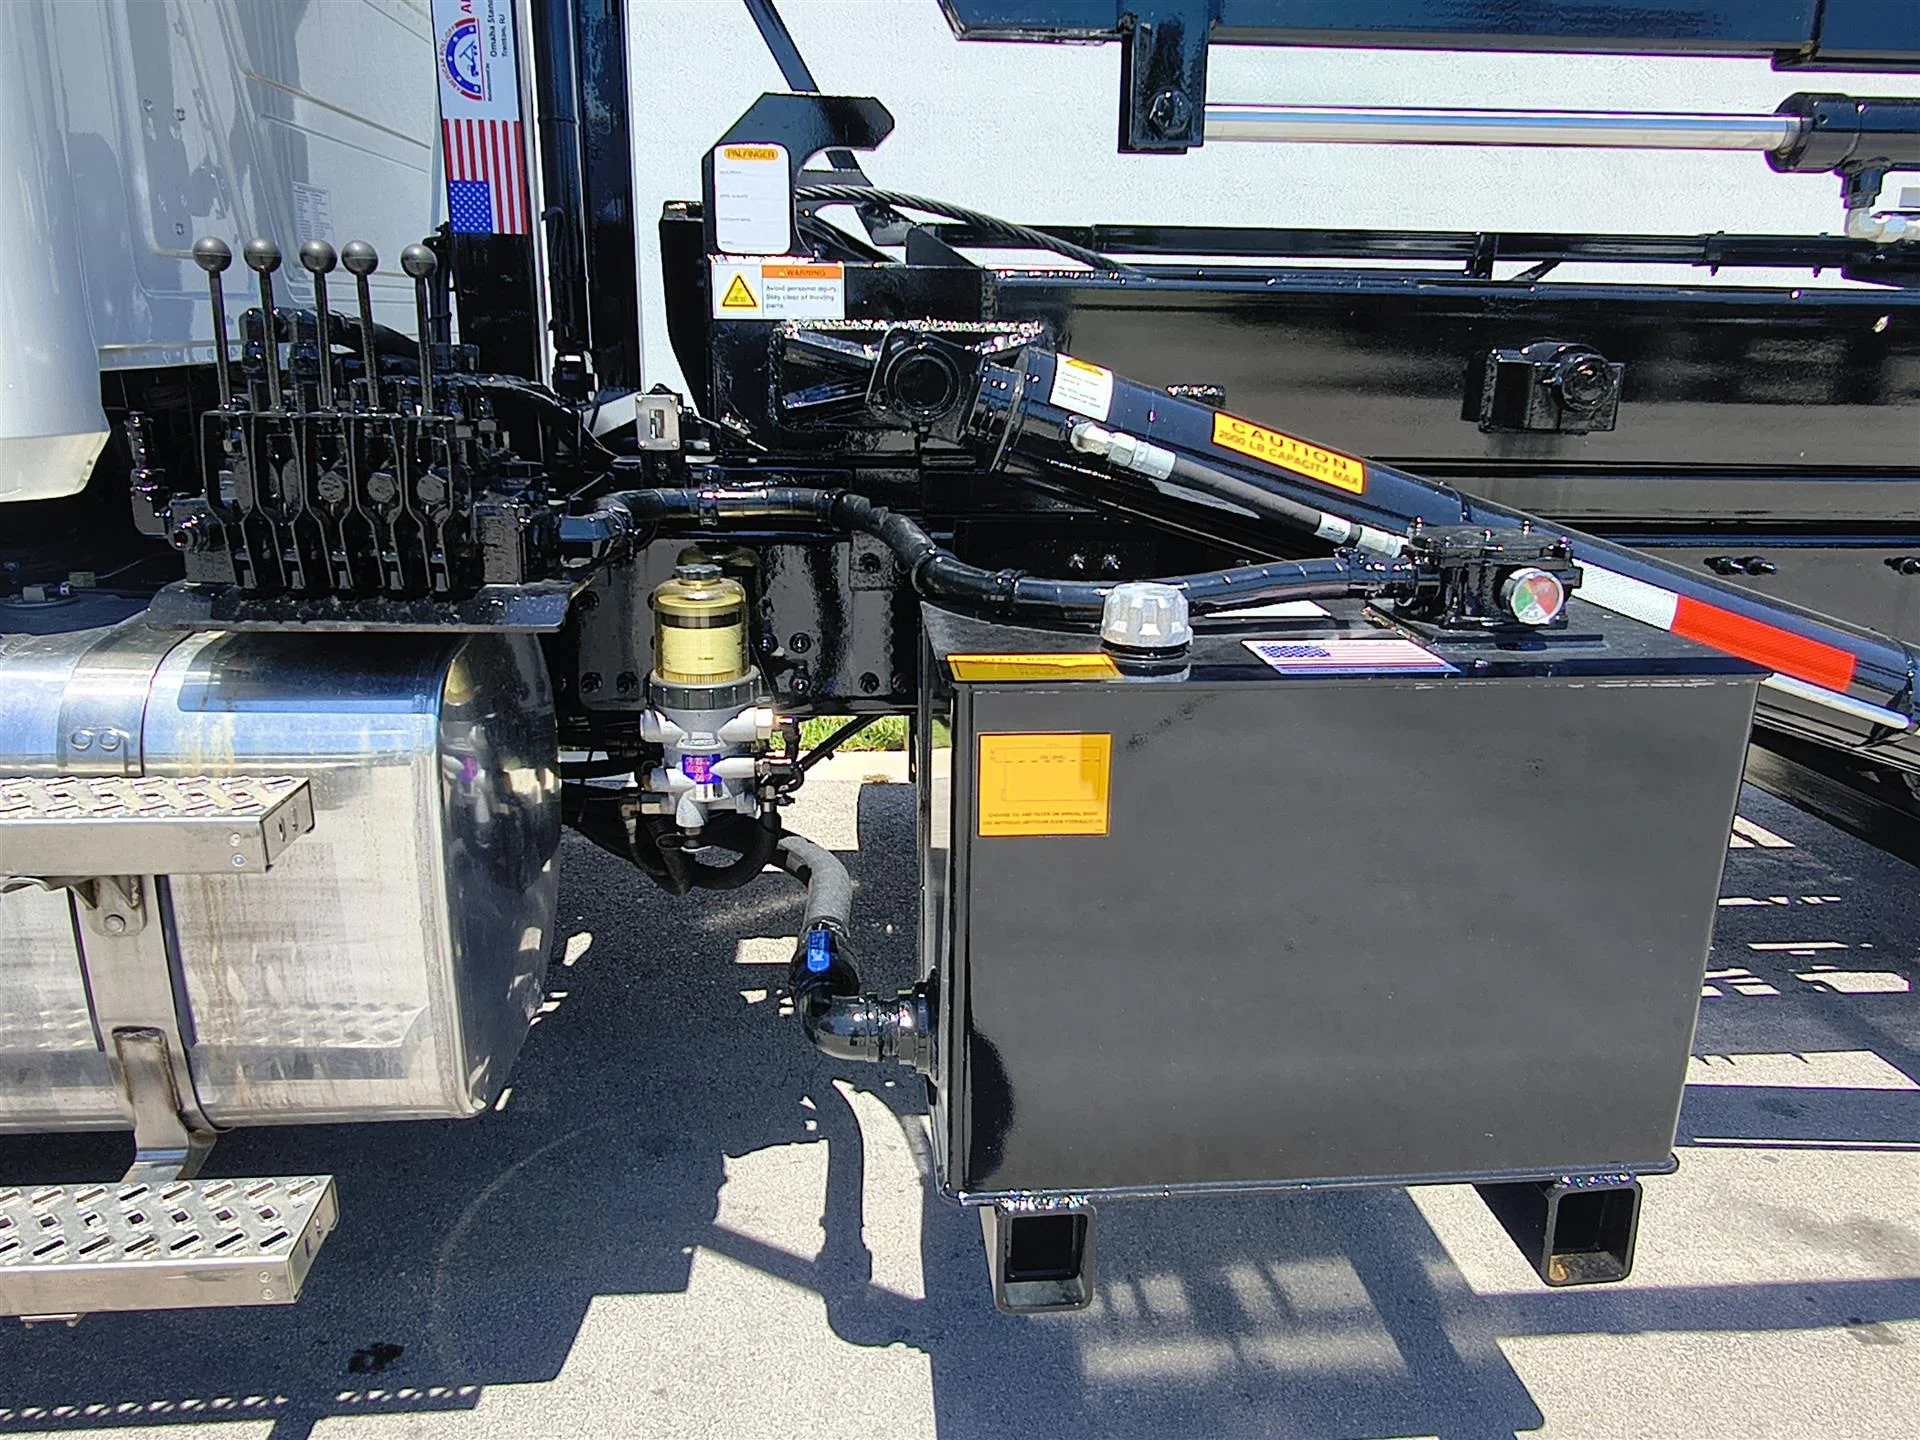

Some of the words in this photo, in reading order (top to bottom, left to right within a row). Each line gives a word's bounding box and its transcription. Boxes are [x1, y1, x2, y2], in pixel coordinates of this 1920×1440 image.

[490, 26, 498, 57] Omaha
[787, 269, 826, 277] WARNING
[1219, 430, 1246, 445] 2000
[1250, 441, 1265, 452] LB
[1269, 447, 1329, 474] CAPACITY
[1333, 470, 1359, 486] MAX
[1232, 422, 1347, 469] CAUTION
